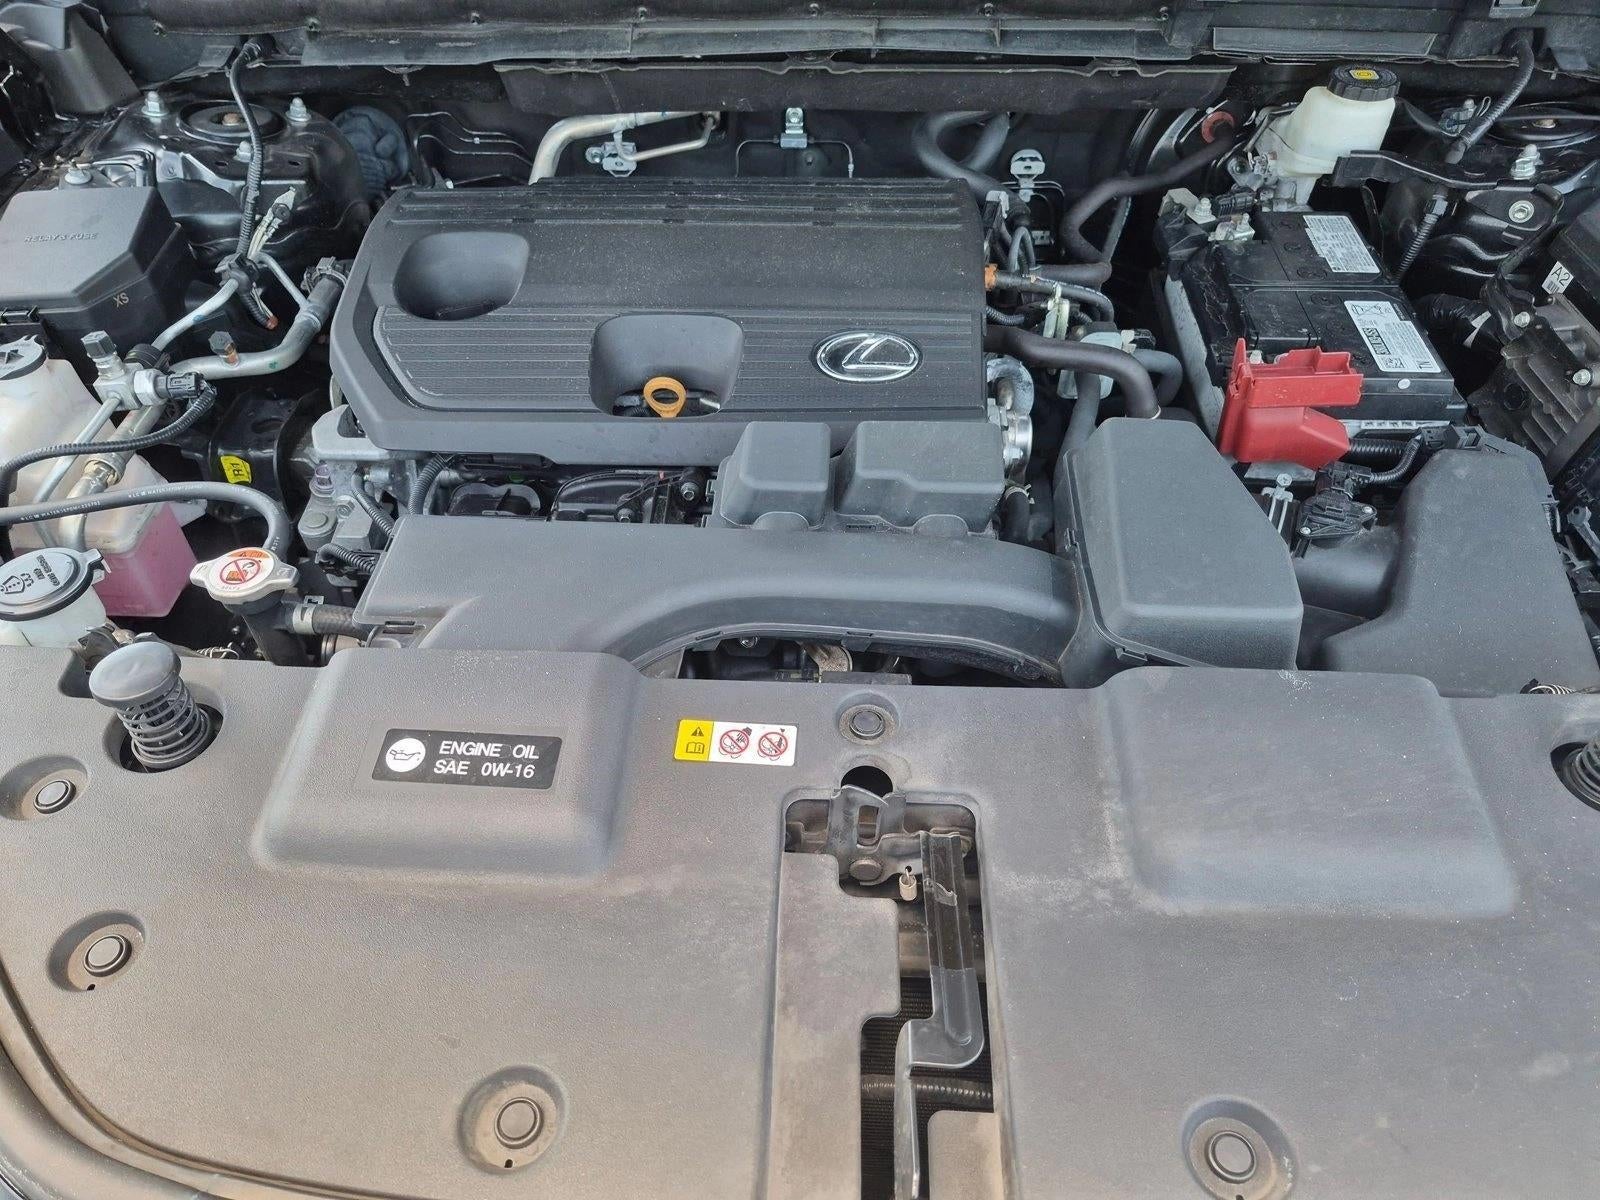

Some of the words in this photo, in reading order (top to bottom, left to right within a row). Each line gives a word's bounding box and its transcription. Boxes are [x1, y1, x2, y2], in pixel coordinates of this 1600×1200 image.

[1550, 266, 1571, 287] A2
[112, 292, 130, 308] XS
[438, 740, 503, 758] ENGINE
[511, 743, 541, 760] OIL
[433, 759, 471, 776] SAE
[480, 761, 536, 779] 0W-16
